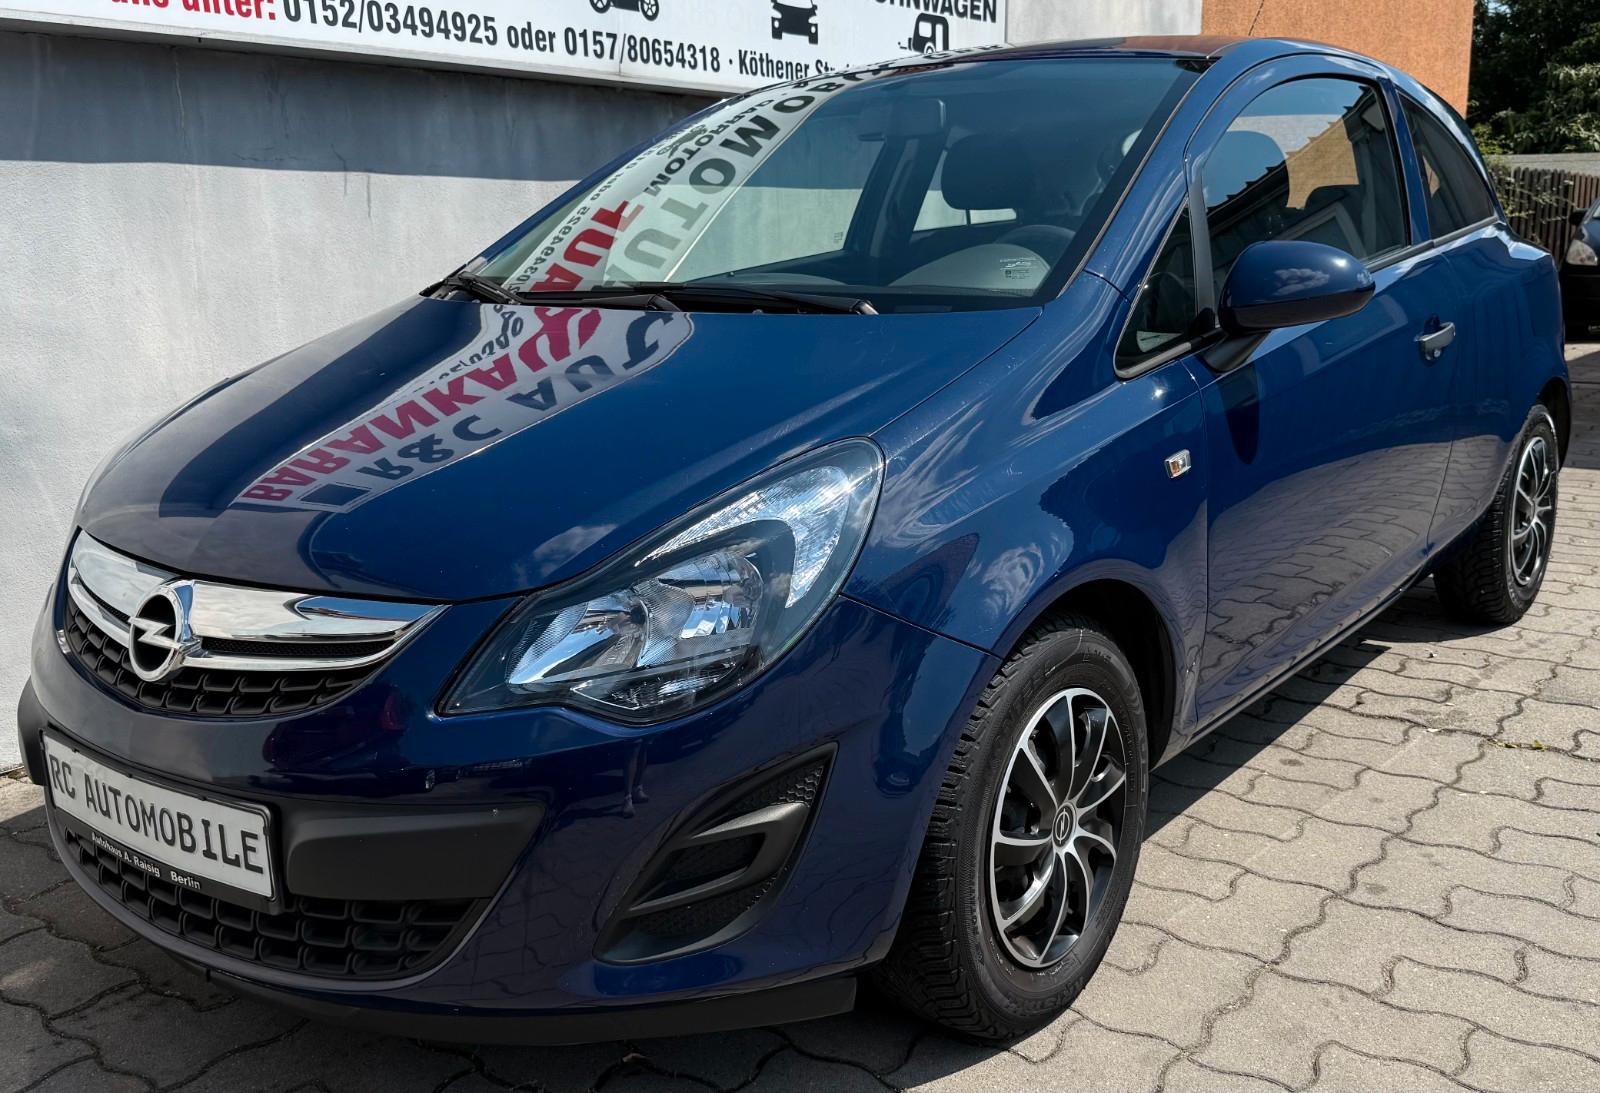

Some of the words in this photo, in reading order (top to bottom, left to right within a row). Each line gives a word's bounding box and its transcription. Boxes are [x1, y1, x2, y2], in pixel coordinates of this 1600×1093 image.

[284, 0, 498, 46] 0152/03494925
[507, 22, 556, 53] oder
[564, 27, 721, 73] 0157/80654318
[738, 49, 810, 81] Köthener
[49, 753, 76, 800] RC
[84, 773, 264, 874] AUTOMOBILE
[134, 856, 161, 878] Raisig
[170, 870, 201, 890] Berlin
